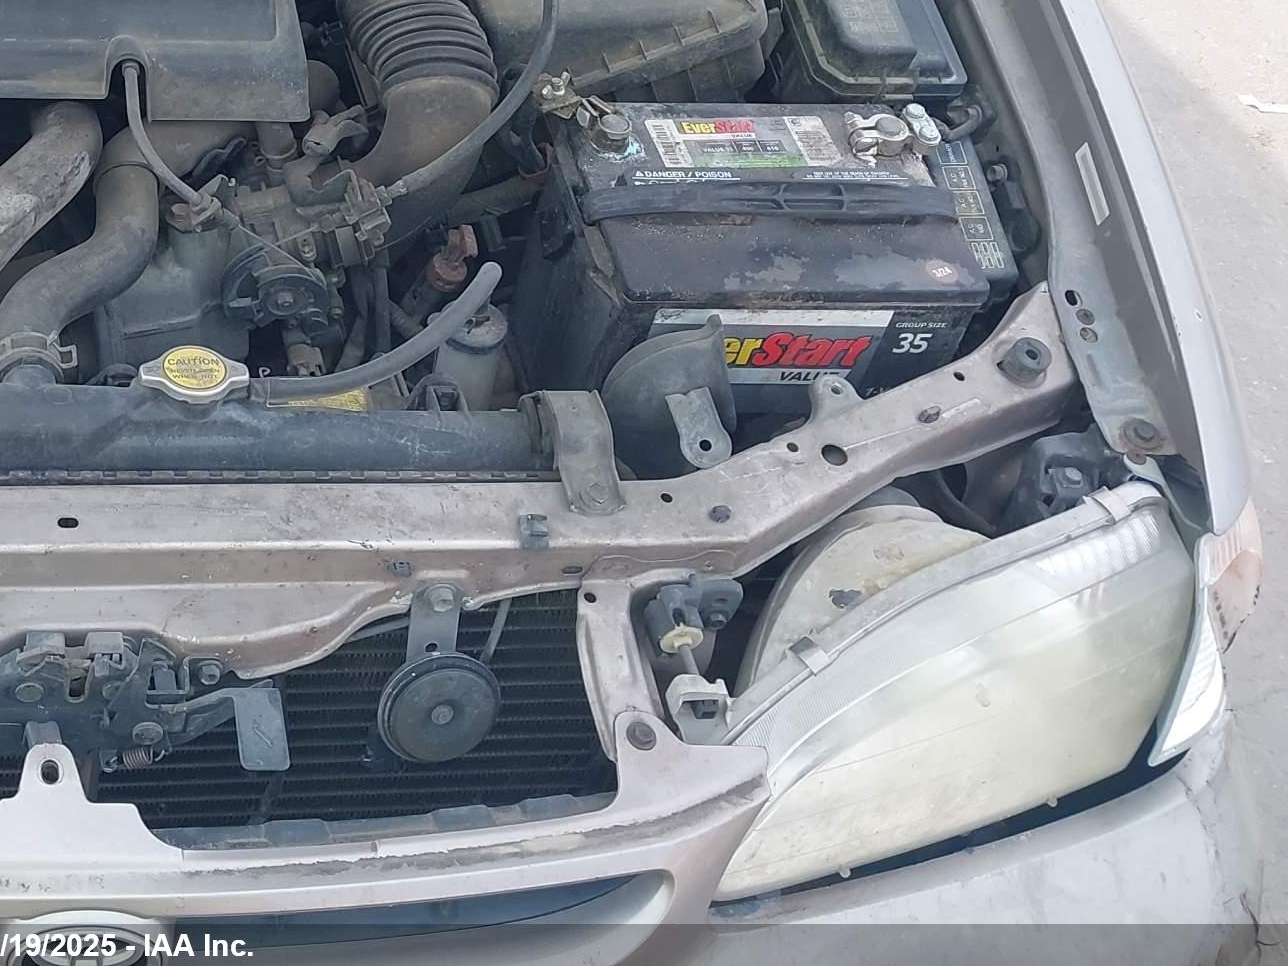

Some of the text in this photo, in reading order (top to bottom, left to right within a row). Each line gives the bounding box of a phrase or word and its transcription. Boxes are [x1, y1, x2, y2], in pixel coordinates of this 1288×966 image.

[681, 121, 754, 134] EverStart
[644, 170, 686, 179] DANGER
[695, 170, 733, 179] POISON
[892, 332, 933, 353] 35
[722, 331, 873, 369] erStart
[167, 357, 219, 366] CAUTION
